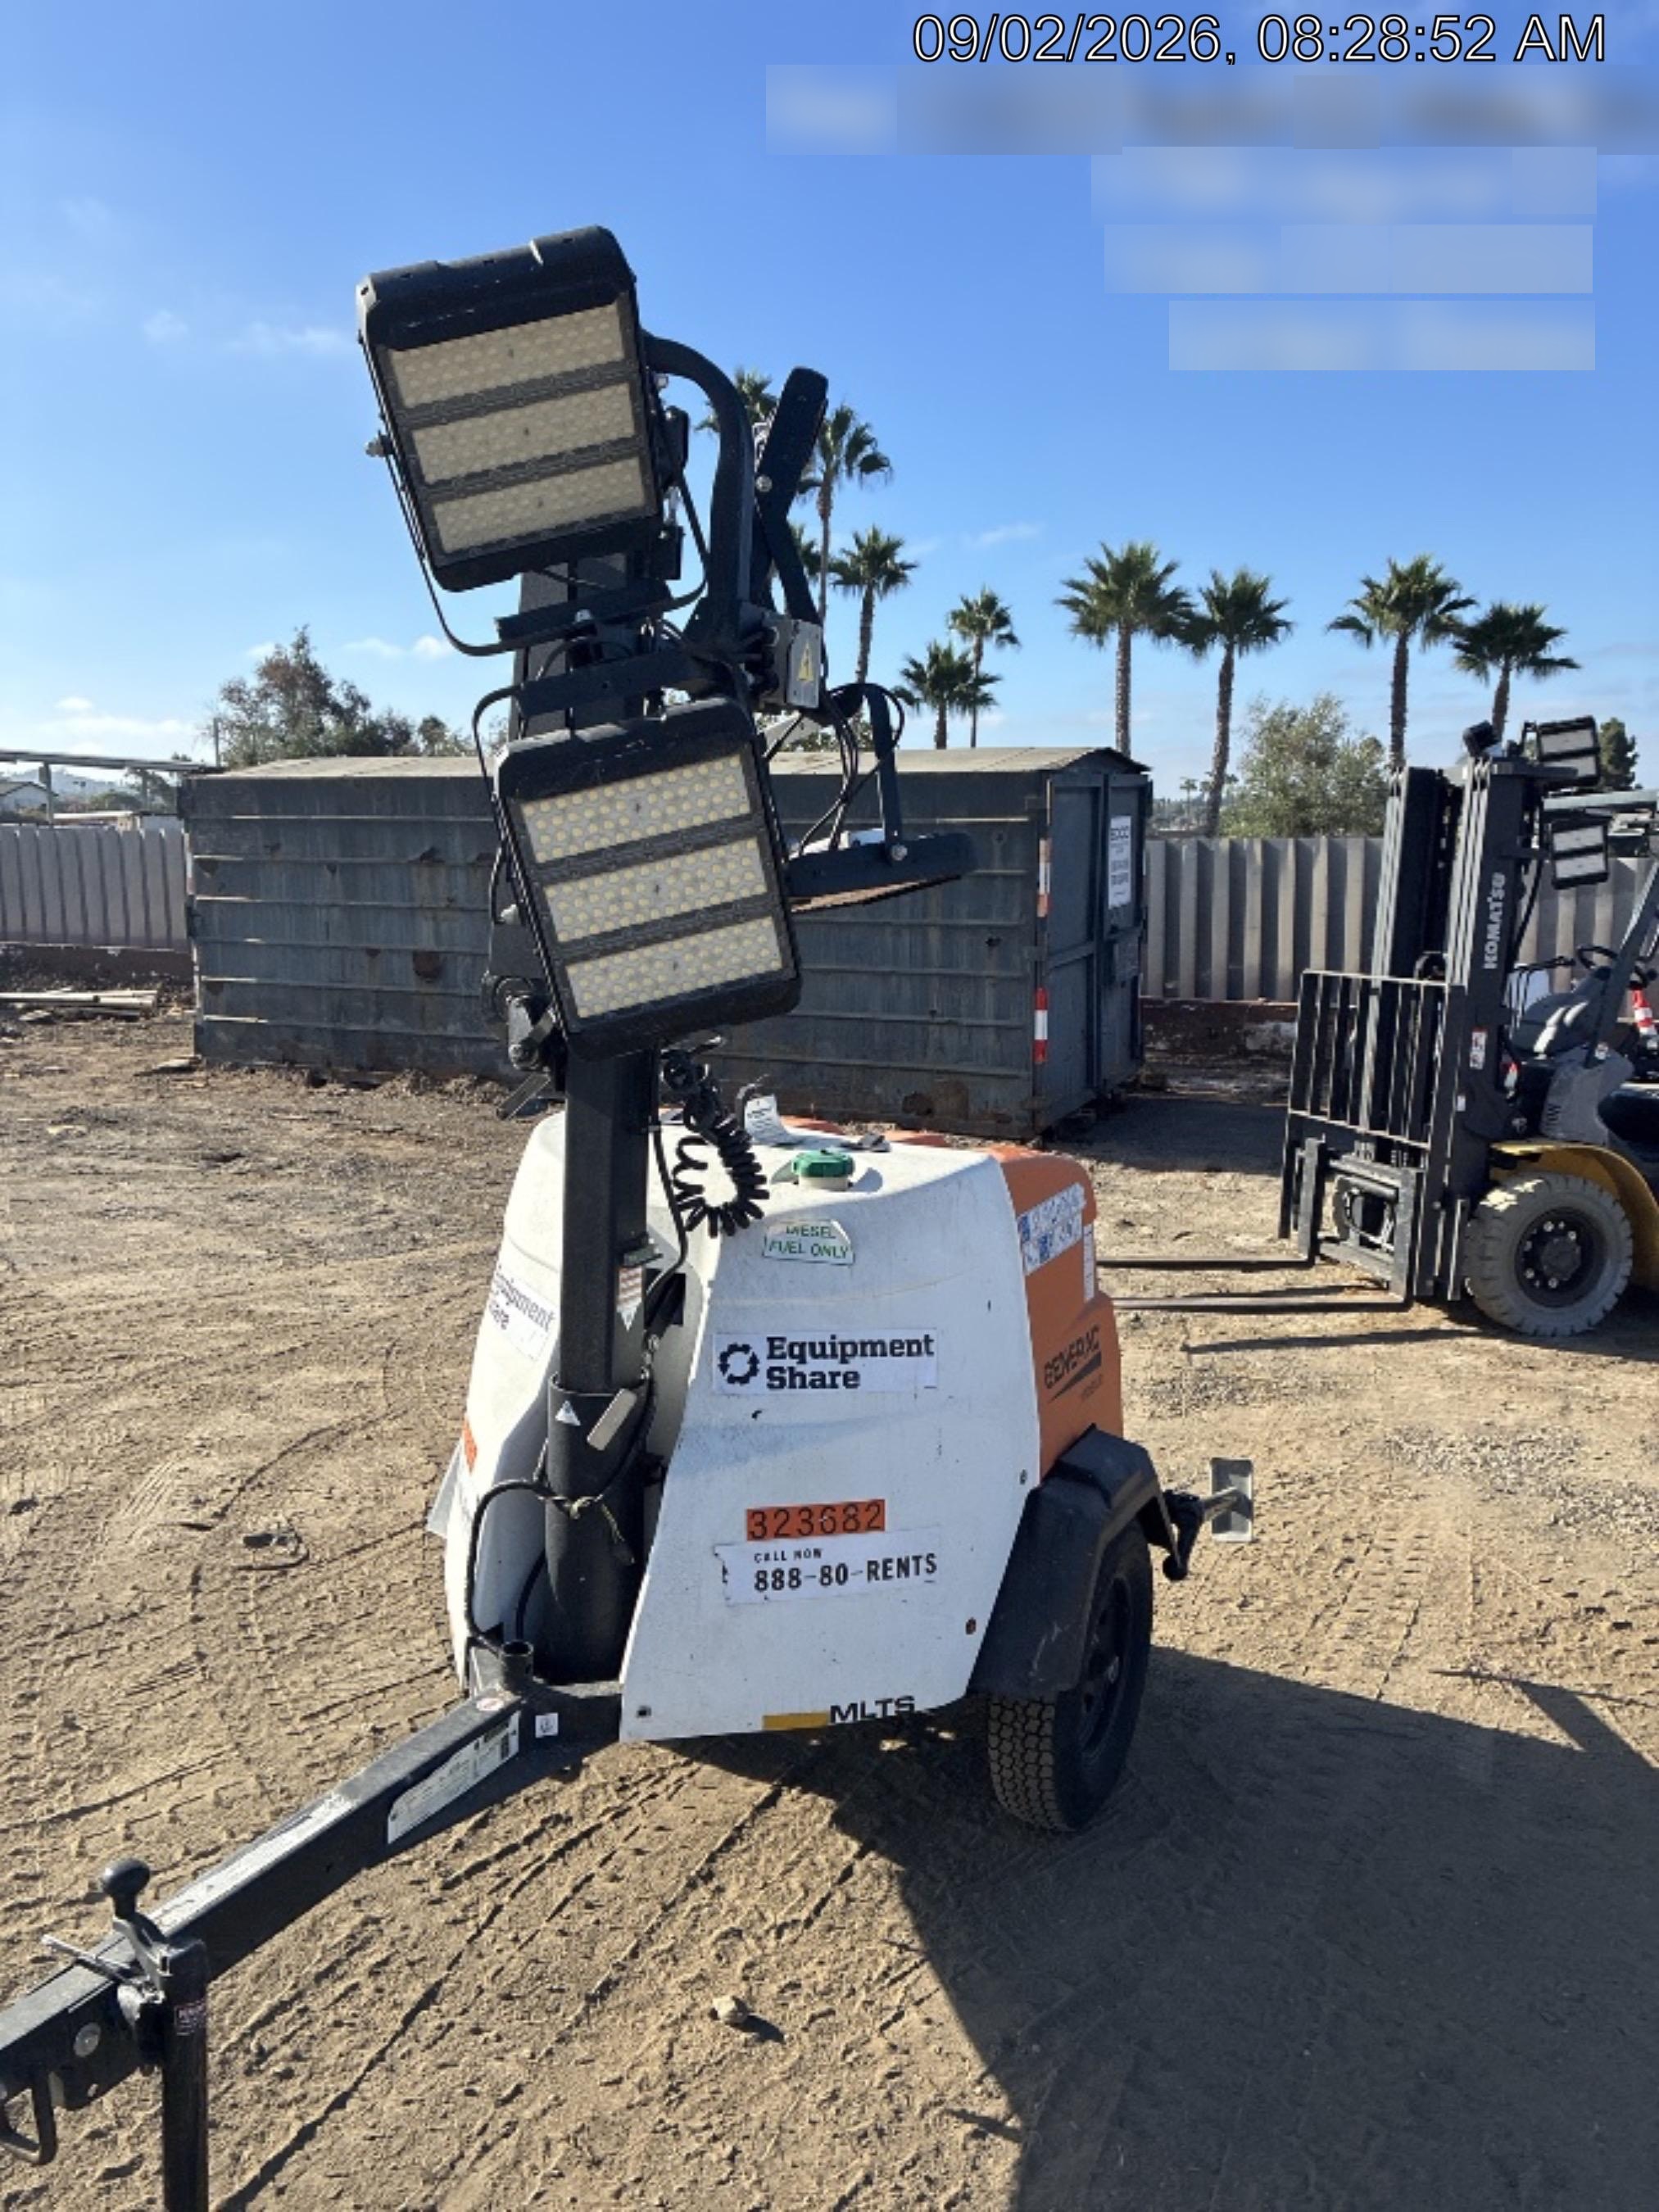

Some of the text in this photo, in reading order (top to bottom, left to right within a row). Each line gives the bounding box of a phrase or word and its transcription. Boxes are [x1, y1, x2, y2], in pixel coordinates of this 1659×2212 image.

[1483, 872, 1506, 969] KOMATSU
[768, 1240, 849, 1259] FUEL ONLY
[766, 1335, 935, 1364] Equipment
[766, 1366, 860, 1389] Share
[750, 1502, 882, 1540] 323682
[754, 1550, 787, 1563] CALL
[754, 1552, 938, 1592] 888-80-RENTS
